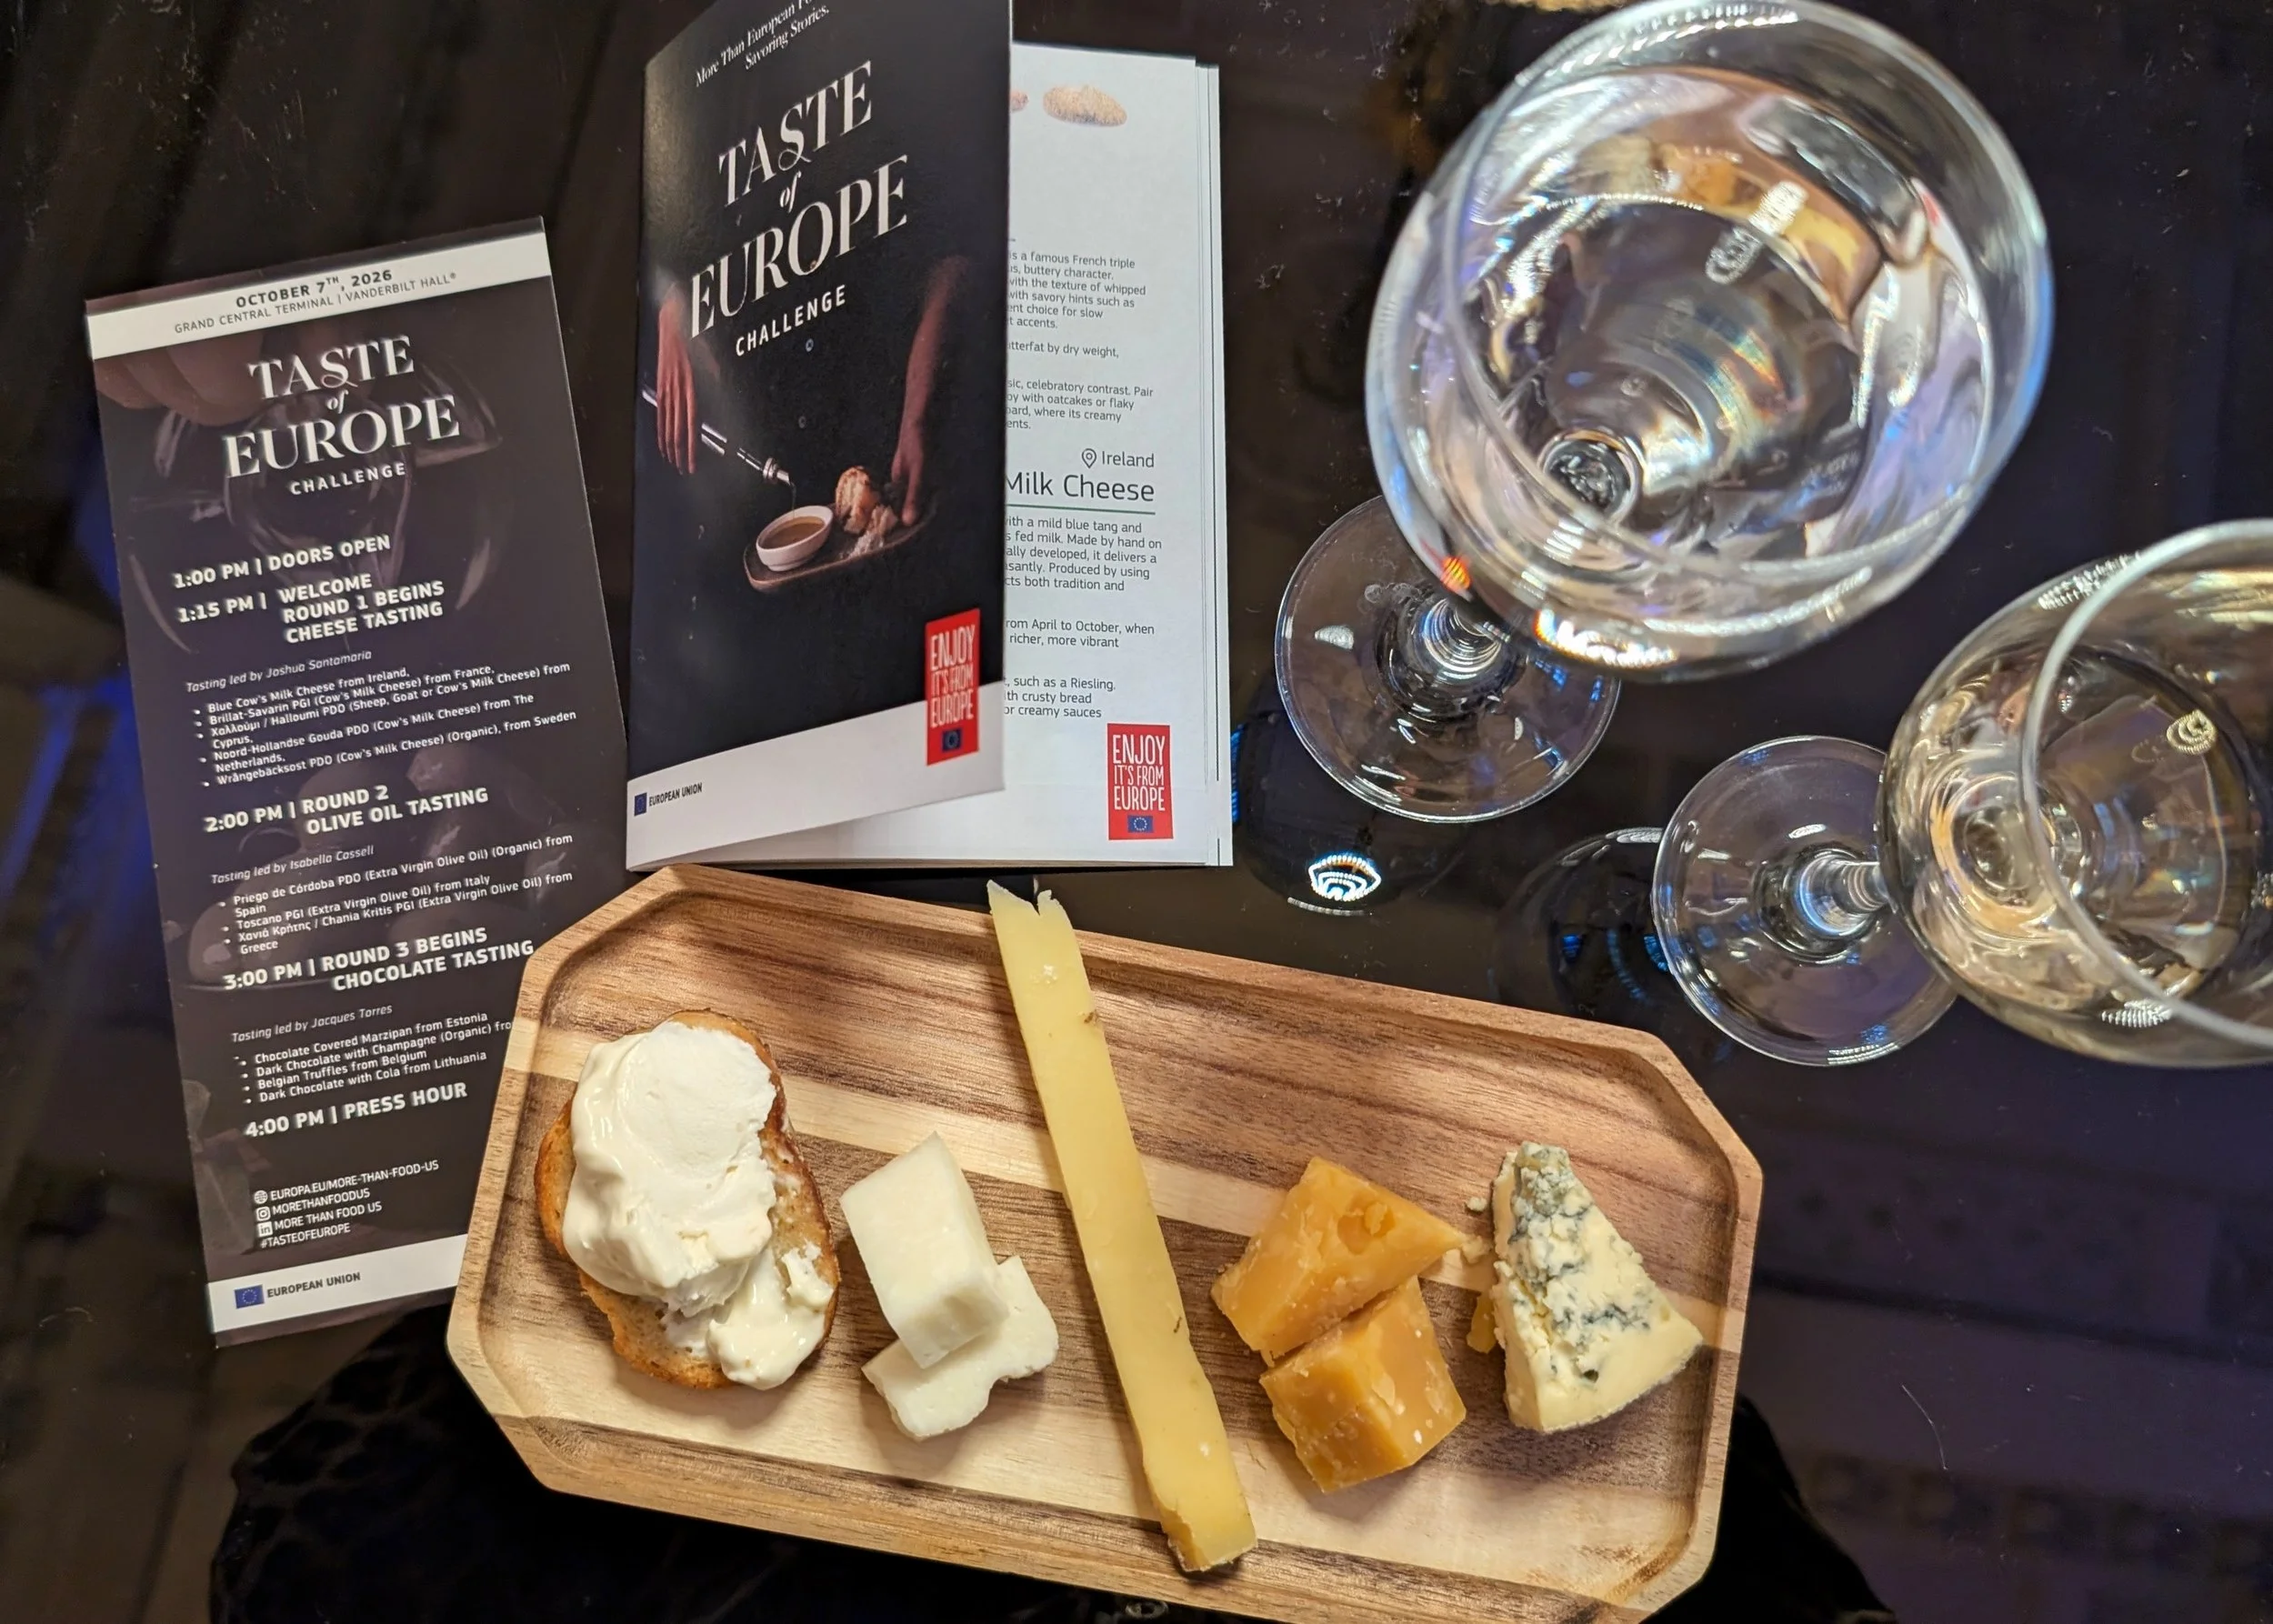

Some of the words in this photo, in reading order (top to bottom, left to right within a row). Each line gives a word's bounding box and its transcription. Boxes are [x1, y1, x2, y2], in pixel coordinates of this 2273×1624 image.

[696, 62, 719, 87] More
[721, 40, 745, 66] Than
[747, 2, 796, 46] European
[746, 31, 788, 70] Savoring
[790, 5, 830, 37] Stories.
[718, 60, 871, 207] TASTE
[779, 171, 802, 213] of
[691, 155, 907, 339] EUROPE
[1020, 253, 1027, 262] a
[1030, 251, 1070, 265] famous
[1072, 254, 1106, 266] French
[1109, 257, 1136, 270] triple
[235, 285, 310, 308] OCTOBER
[351, 269, 392, 287] 2026
[1023, 264, 1061, 279] buttery
[1064, 266, 1114, 280] character.
[175, 317, 215, 334] GRAND
[218, 307, 271, 326] CENTRAL
[274, 296, 334, 315] TERMINAL
[345, 280, 416, 302] VANDERBILT
[736, 285, 846, 356] CHALLENGE
[248, 335, 415, 399] TASTE
[326, 389, 347, 414] of
[224, 394, 460, 478] EUROPE
[1102, 450, 1155, 468] Ireland
[290, 462, 406, 496] CHALLENGE
[1063, 474, 1155, 502] Cheese
[1015, 529, 1034, 543] fed
[1036, 532, 1064, 545] milk.
[1066, 533, 1097, 546] Made
[1100, 534, 1115, 549] by
[1116, 536, 1146, 548] hand
[1147, 540, 1162, 549] on
[1026, 518, 1035, 528] a
[1037, 516, 1063, 529] mild
[1065, 517, 1090, 531] blue
[1092, 520, 1118, 535] tang
[1121, 522, 1142, 534] and
[174, 567, 216, 589] 1:00
[221, 561, 250, 580] PM
[267, 546, 335, 571] DOORS
[339, 535, 391, 557] OPEN
[177, 601, 220, 623] 1:15
[225, 595, 254, 614] PM
[276, 573, 373, 604] WELCOME
[282, 598, 350, 624] ROUND
[356, 595, 369, 610] 1
[374, 580, 445, 606] BEGINS
[285, 617, 358, 644] CHEESE
[362, 601, 444, 629] TASTING
[1006, 619, 1028, 629] rom
[1031, 618, 1057, 632] April
[1060, 620, 1072, 631] to
[1075, 620, 1122, 635] October,
[1125, 622, 1155, 635] when
[1009, 632, 1045, 647] richer,
[1047, 636, 1077, 647] more
[1079, 635, 1119, 648] vibrant
[931, 624, 976, 671] ENJOY
[207, 701, 233, 714] Blue
[235, 695, 268, 708] Cow's
[269, 688, 294, 702] Milk
[295, 682, 335, 697] Cheese
[337, 677, 365, 688] from
[367, 667, 410, 684] Ireland,
[208, 703, 289, 726] Brillat-Savarin
[291, 697, 311, 710] PGI
[314, 692, 350, 707] (Cow's
[352, 686, 375, 698] Milk
[377, 677, 422, 694] Cheese)
[424, 673, 452, 685] from
[454, 666, 495, 679] France,
[931, 669, 948, 697] IT'S
[949, 663, 974, 692] FROM
[1013, 676, 1040, 687] such
[1043, 678, 1056, 688] as
[1059, 679, 1067, 688] a
[1070, 677, 1116, 693] Riesling.
[1021, 691, 1056, 706] crusty
[1059, 691, 1092, 705] bread
[930, 688, 974, 727] EUROPE
[1017, 707, 1060, 719] creamy
[1063, 707, 1102, 718] sauces
[215, 753, 285, 773] Netherlands,
[1112, 734, 1166, 765] ENJOY
[649, 788, 680, 807] EUROPEAN
[682, 782, 703, 797] UNION
[1114, 765, 1135, 786] IT'S
[1136, 765, 1165, 787] FROM
[205, 811, 249, 833] 2:00
[254, 804, 283, 824] PM
[301, 788, 370, 815] ROUND
[375, 785, 389, 801] 2
[305, 810, 365, 835] OLIVE
[368, 804, 404, 823] OIL
[406, 787, 488, 816] TASTING
[1114, 786, 1166, 811] EUROPE
[233, 892, 269, 906] Priego
[271, 887, 286, 898] de
[288, 879, 335, 895] Córdoba
[337, 872, 362, 886] PDO
[365, 867, 398, 882] (Extra
[400, 860, 434, 874] Virgin
[436, 855, 466, 867] Olive
[468, 848, 488, 861] Oil)
[491, 838, 543, 857] (Organic)
[545, 835, 573, 847] from
[235, 915, 283, 929] Toscano
[285, 908, 305, 921] PGI
[307, 903, 341, 917] (Extra
[343, 896, 377, 910] Virgin
[379, 890, 408, 903] Olive
[411, 885, 432, 897] Oil)
[434, 880, 462, 893] from
[465, 874, 490, 887] Italy
[235, 901, 266, 918] Spain
[223, 968, 268, 990] 3:00
[273, 961, 303, 981] PM
[321, 946, 390, 972] ROUND
[396, 941, 410, 957] 3
[415, 927, 487, 955] BEGINS
[239, 940, 279, 955] Greece
[332, 956, 447, 991] CHOCOLATE
[451, 939, 534, 968] TASTING
[255, 1047, 310, 1065] Chocolate
[313, 1035, 359, 1053] Covered
[360, 1027, 413, 1044] Marzipan
[415, 1021, 444, 1034] from
[446, 1013, 488, 1028] Estonia
[257, 1074, 300, 1090] Belgian
[302, 1065, 348, 1081] Truffles
[350, 1059, 379, 1072] from
[381, 1050, 427, 1067] Belgium
[245, 1116, 290, 1138] 4:00
[295, 1108, 325, 1129] PM
[343, 1093, 406, 1119] PRESS
[411, 1082, 467, 1107] HOUR
[272, 1188, 371, 1216] MORETHANFOODUS
[274, 1215, 305, 1230] MORE
[305, 1210, 335, 1224] THAN
[335, 1204, 365, 1218] FOOD
[366, 1200, 383, 1213] US
[260, 1222, 351, 1248] #TASTEOFEUROPE
[266, 1278, 324, 1298] EUROPEAN
[325, 1271, 361, 1287] UNION
